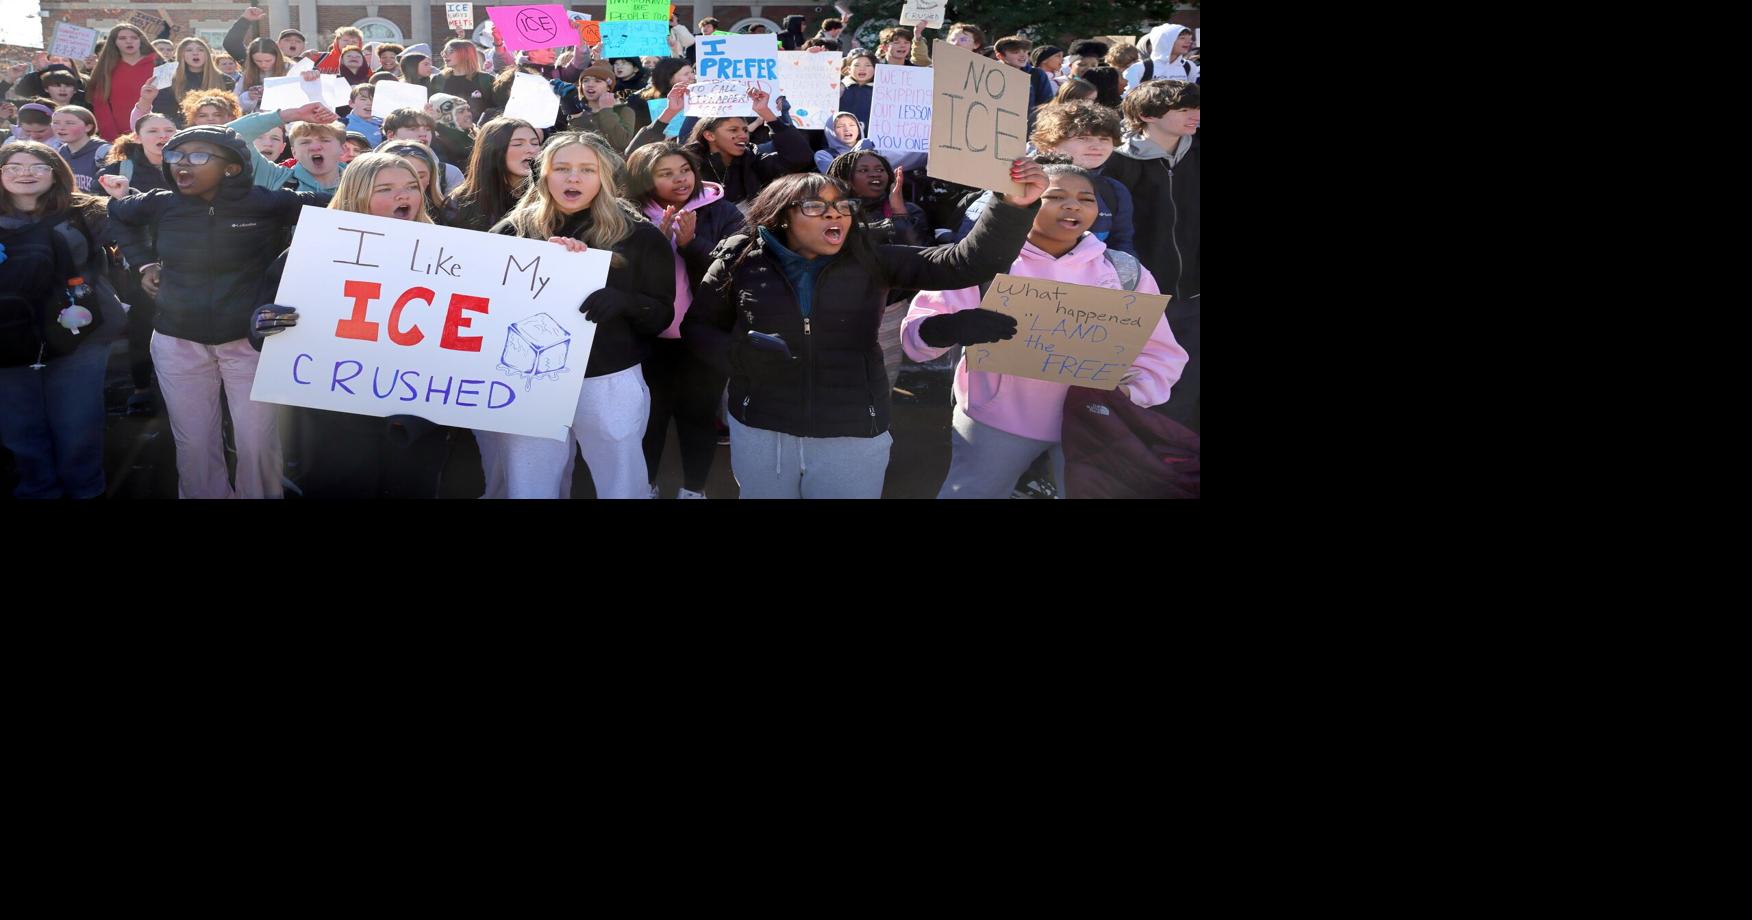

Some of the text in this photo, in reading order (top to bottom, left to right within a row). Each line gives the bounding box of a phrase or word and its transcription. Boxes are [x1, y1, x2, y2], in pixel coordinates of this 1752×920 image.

[447, 3, 469, 12] ICE
[610, 11, 649, 20] PEOPLE
[448, 19, 473, 27] MELTS
[520, 16, 552, 32] ICE
[701, 39, 727, 56] I
[700, 57, 777, 80] PREFER
[963, 60, 1006, 99] NO
[938, 92, 1020, 161] ICE
[877, 134, 929, 150] YOU ONE
[332, 227, 385, 267] I
[501, 254, 551, 300] My
[996, 281, 1068, 301] What
[334, 279, 490, 353] ICE
[1055, 303, 1143, 328] happened
[1023, 334, 1056, 353] the
[292, 353, 516, 409] CRUSHED
